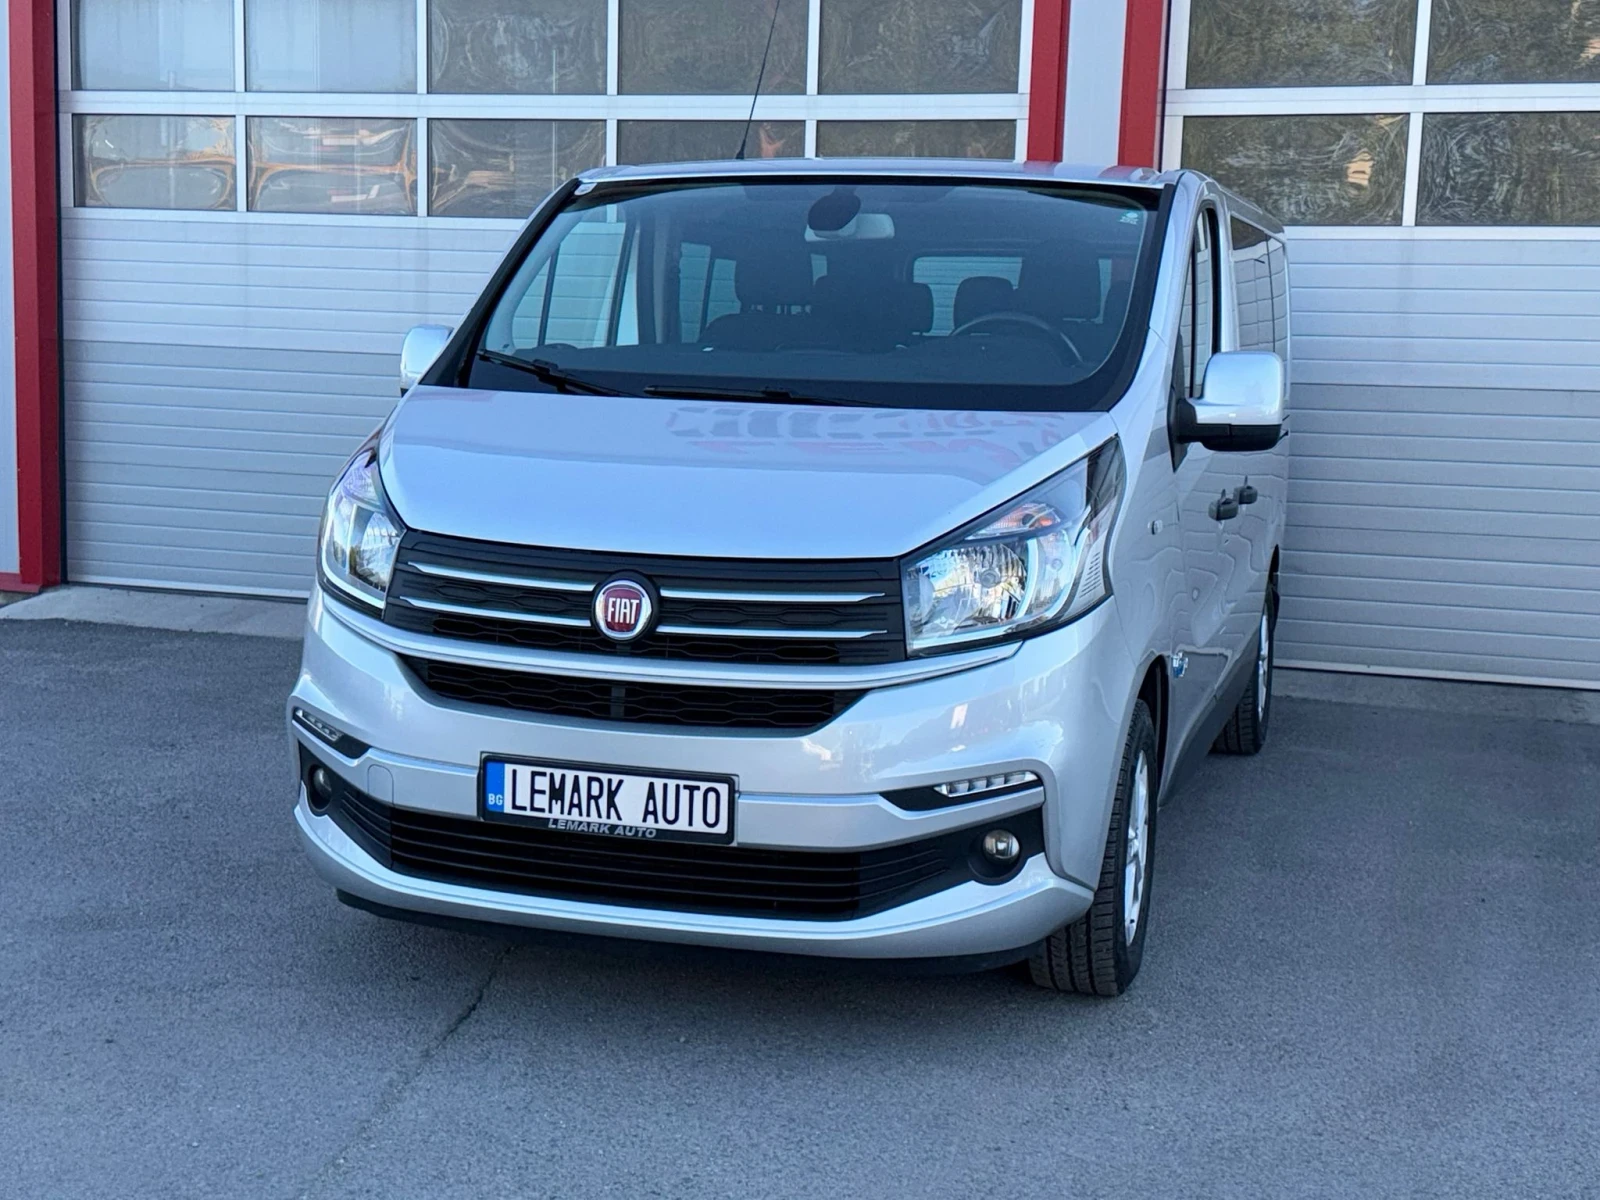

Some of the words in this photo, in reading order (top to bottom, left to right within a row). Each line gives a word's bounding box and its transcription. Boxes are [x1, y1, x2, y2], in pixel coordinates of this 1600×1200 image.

[607, 597, 640, 625] FIAT
[488, 793, 503, 806] BG
[511, 768, 624, 821] LEMARK
[642, 781, 721, 829] AUTO
[548, 818, 610, 834] LEMARK
[616, 825, 657, 839] AUTO
